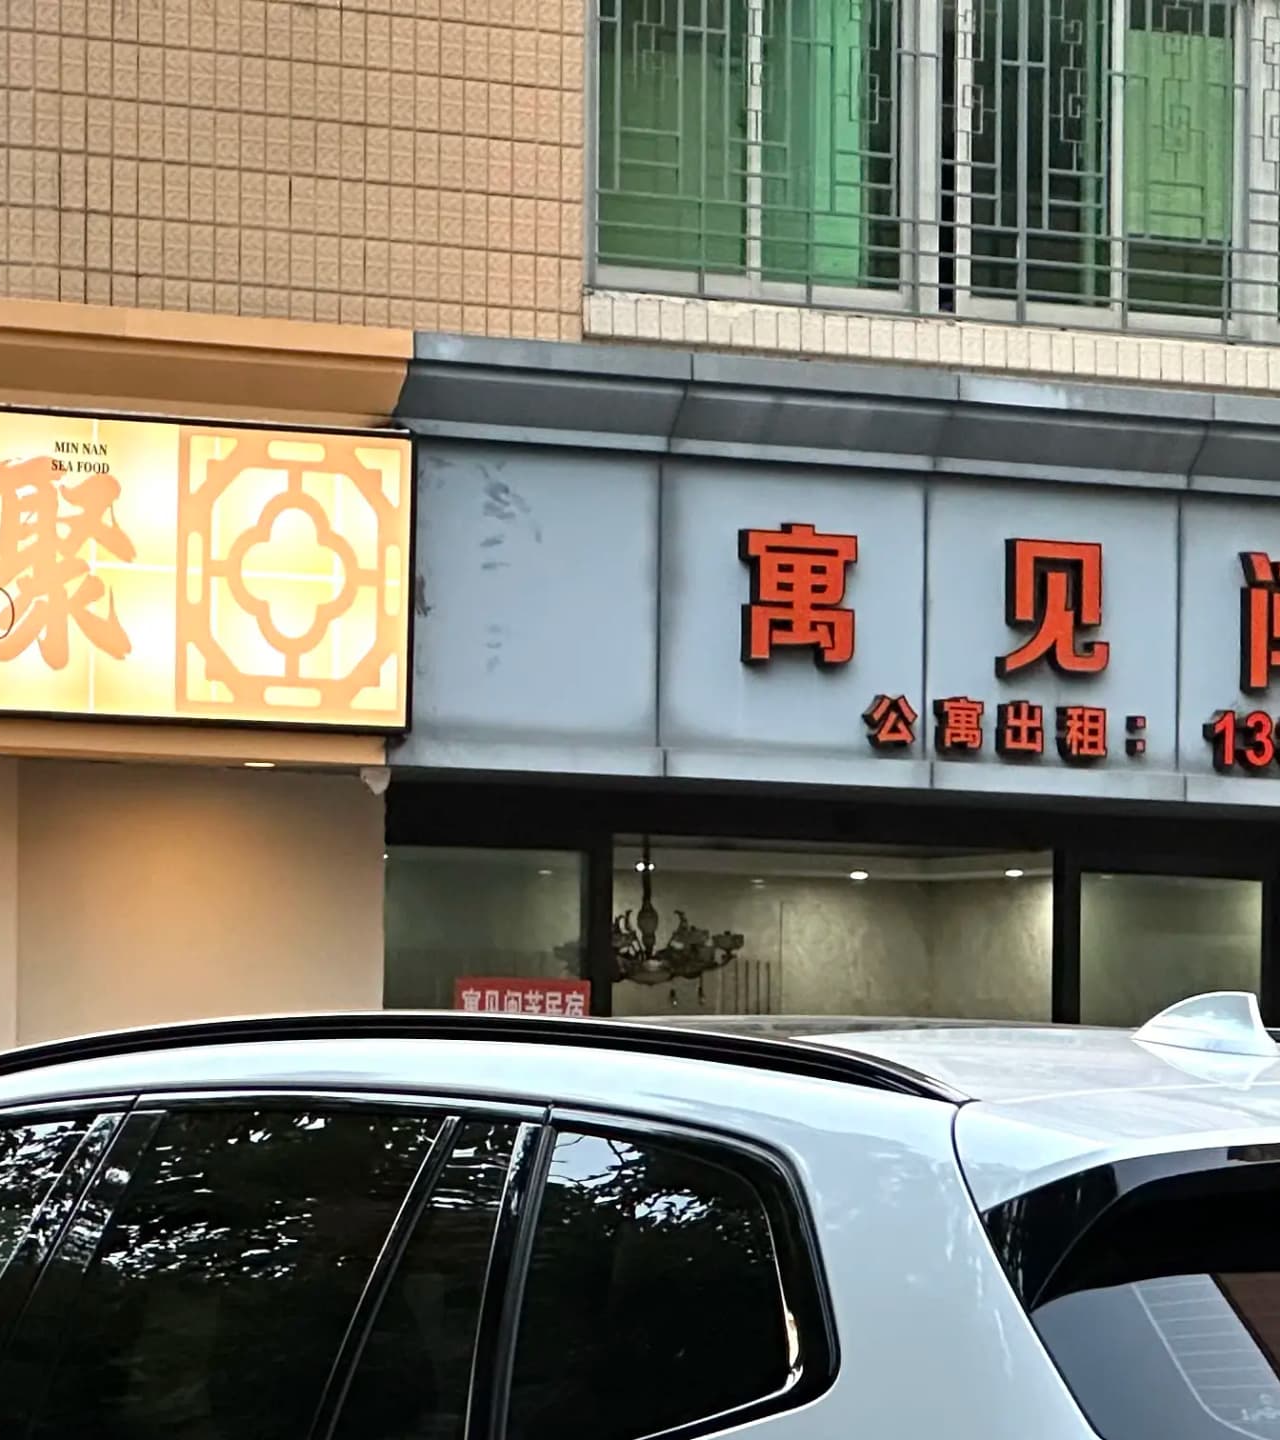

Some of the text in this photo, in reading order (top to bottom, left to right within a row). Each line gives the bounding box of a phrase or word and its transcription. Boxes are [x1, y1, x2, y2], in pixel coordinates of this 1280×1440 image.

[54, 441, 108, 456] MIN NAN
[51, 459, 110, 474] SEA FOOD
